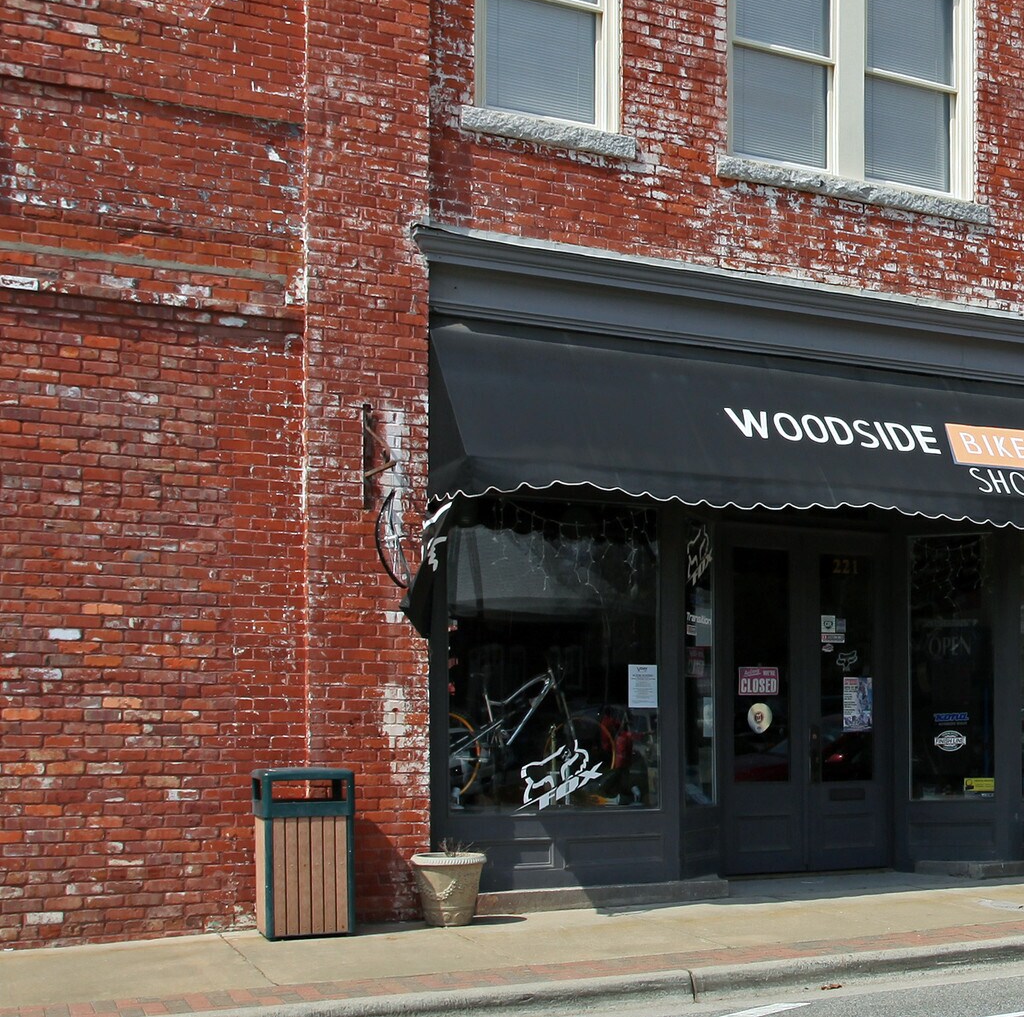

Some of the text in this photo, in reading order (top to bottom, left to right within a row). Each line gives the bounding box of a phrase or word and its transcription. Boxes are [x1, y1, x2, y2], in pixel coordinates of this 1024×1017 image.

[723, 407, 942, 455] WOODSIDE
[832, 559, 858, 574] 221
[927, 635, 972, 657] OPEN
[741, 678, 777, 693] CLOSED
[514, 761, 603, 810] FOX
